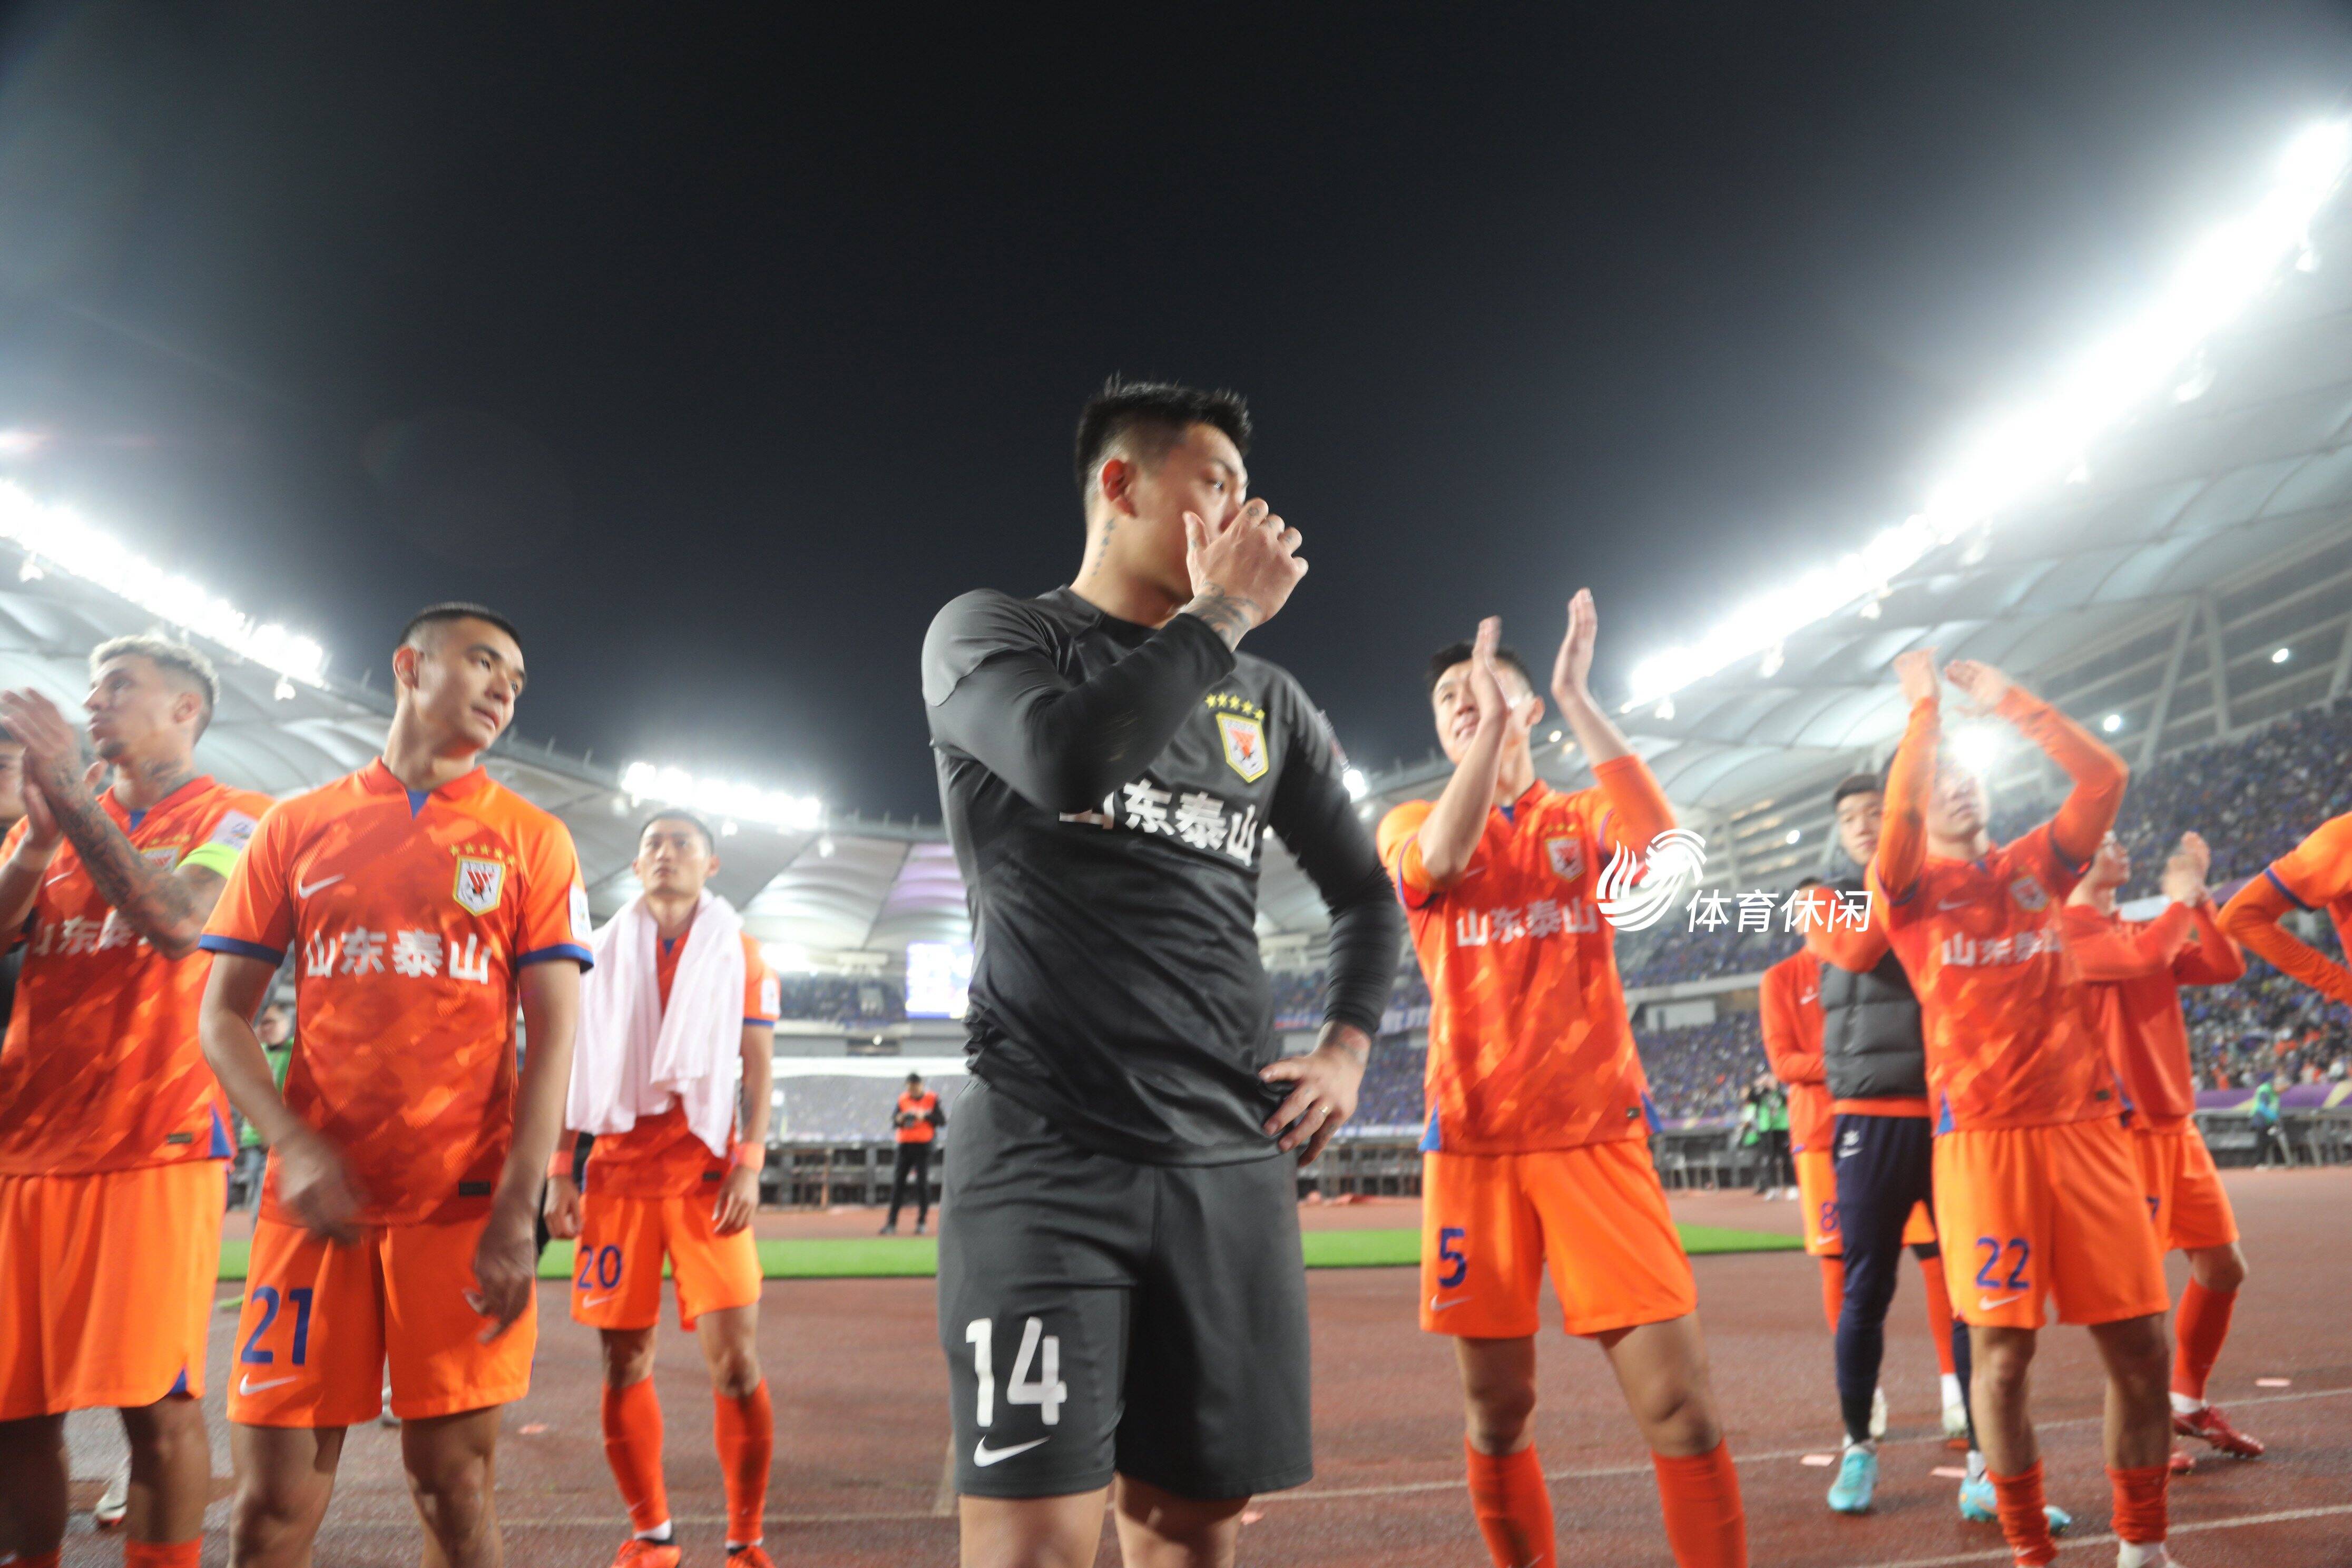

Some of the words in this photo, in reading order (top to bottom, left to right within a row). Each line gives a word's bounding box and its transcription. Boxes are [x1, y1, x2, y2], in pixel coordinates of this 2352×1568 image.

[1456, 897, 1598, 947] 山东泰山
[306, 926, 492, 984] 山东泰山
[577, 1244, 622, 1289] 20
[1438, 1228, 1467, 1287] 5
[1976, 1237, 2030, 1289] 22
[241, 1286, 313, 1365] 21
[965, 1317, 1067, 1427] 14
